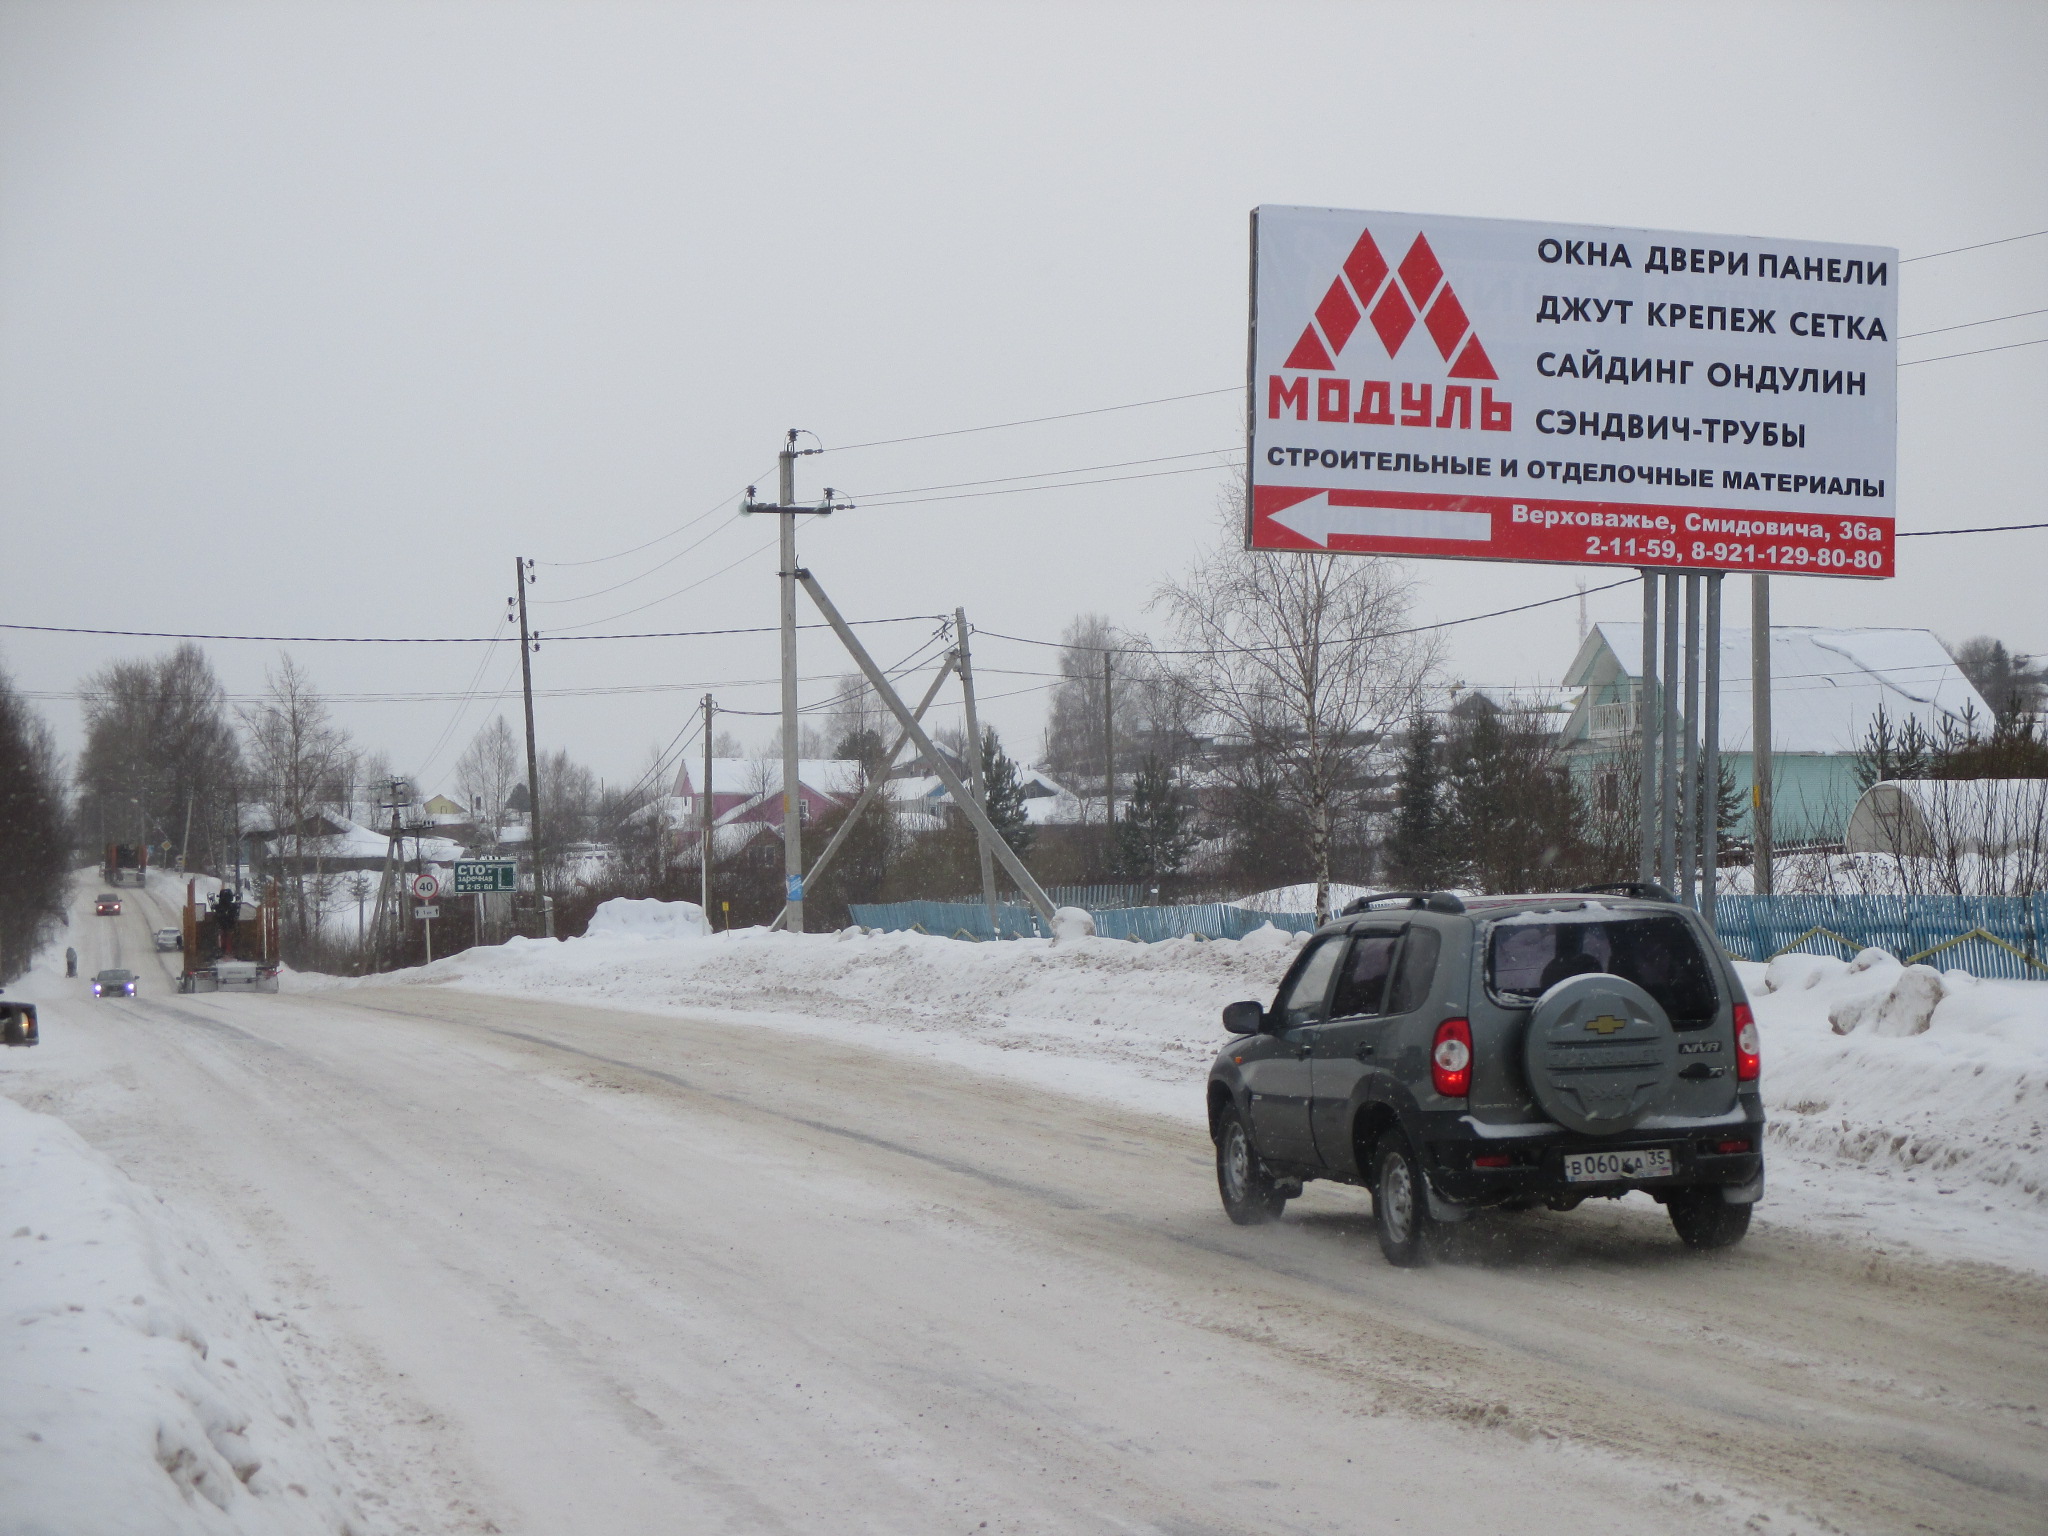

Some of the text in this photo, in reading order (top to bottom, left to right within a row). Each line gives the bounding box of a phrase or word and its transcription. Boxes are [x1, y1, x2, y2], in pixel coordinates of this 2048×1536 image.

[1537, 238, 1888, 287] ОКНА ДВЕРИ ПАНЕЛИ
[1536, 295, 1888, 342] ДЖУТ КРЕПЕЖ СЕТКА
[1536, 348, 1866, 396] САЙДИНГ ОНДУЛИН
[1268, 375, 1512, 432] МОДУЛЬ
[1535, 408, 1805, 448] СЭНДВИЧ-ТРУБЫ
[1267, 446, 1885, 498] СТРОИТЕЛЬНЫЕ И ОТДЕЛОЧНЫЕ МАТЕРИАЛЫ
[1512, 504, 1882, 542] Верховажье, Смидовича, 36а
[1586, 536, 1882, 569] 2-11-59, 8-921-129-80-80
[419, 882, 433, 891] 40
[457, 864, 486, 875] СТО
[1681, 1042, 1720, 1053] NIVA
[1648, 1151, 1665, 1165] 35
